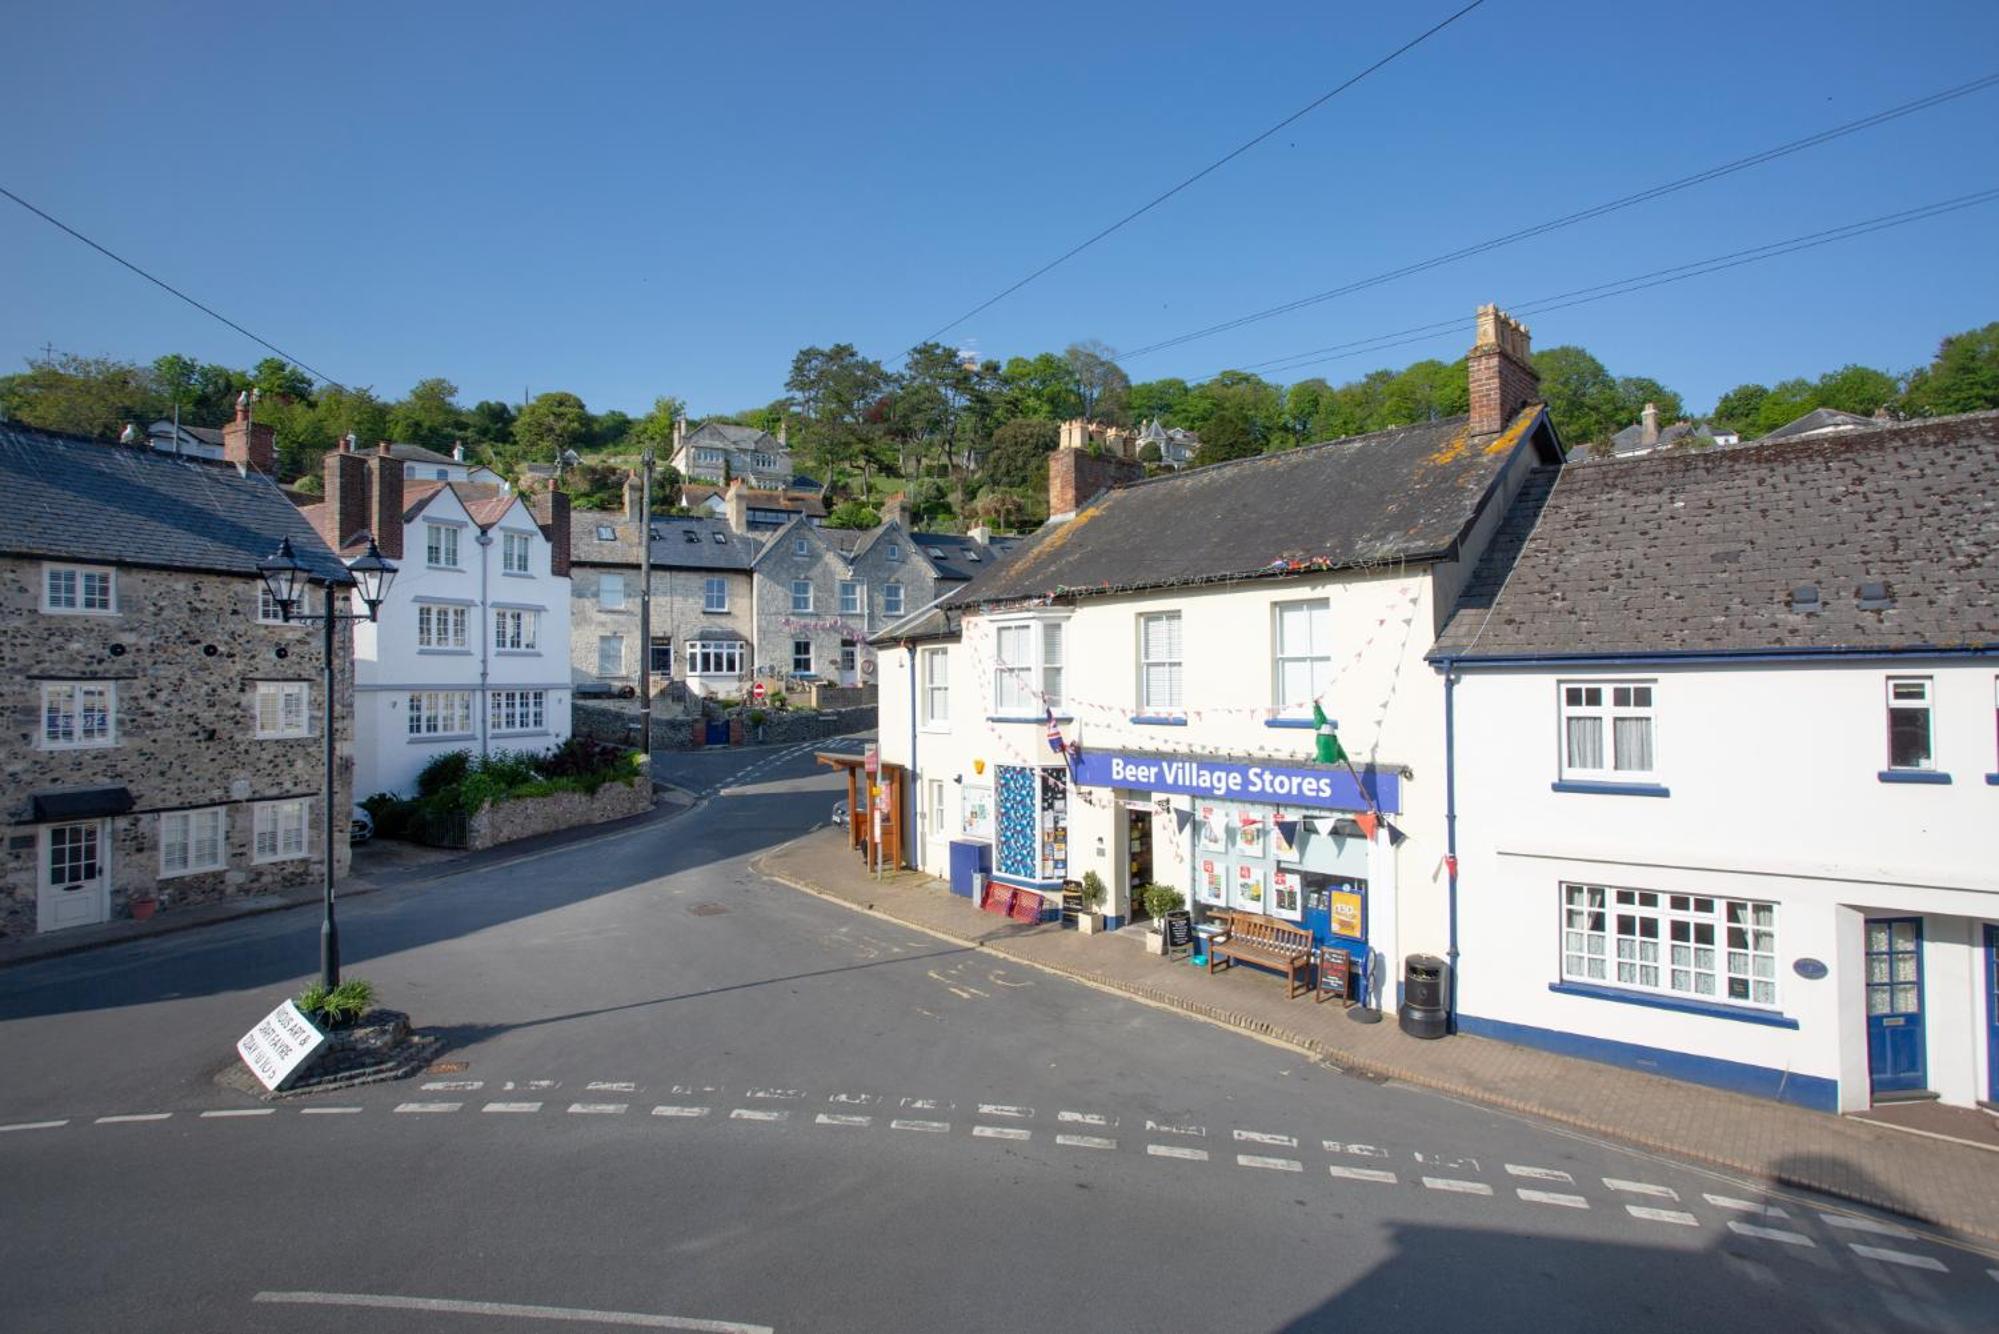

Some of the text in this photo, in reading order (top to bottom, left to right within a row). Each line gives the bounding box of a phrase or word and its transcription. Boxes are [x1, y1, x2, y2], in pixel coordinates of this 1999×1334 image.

[1111, 758, 1332, 798] Beer Village Stores
